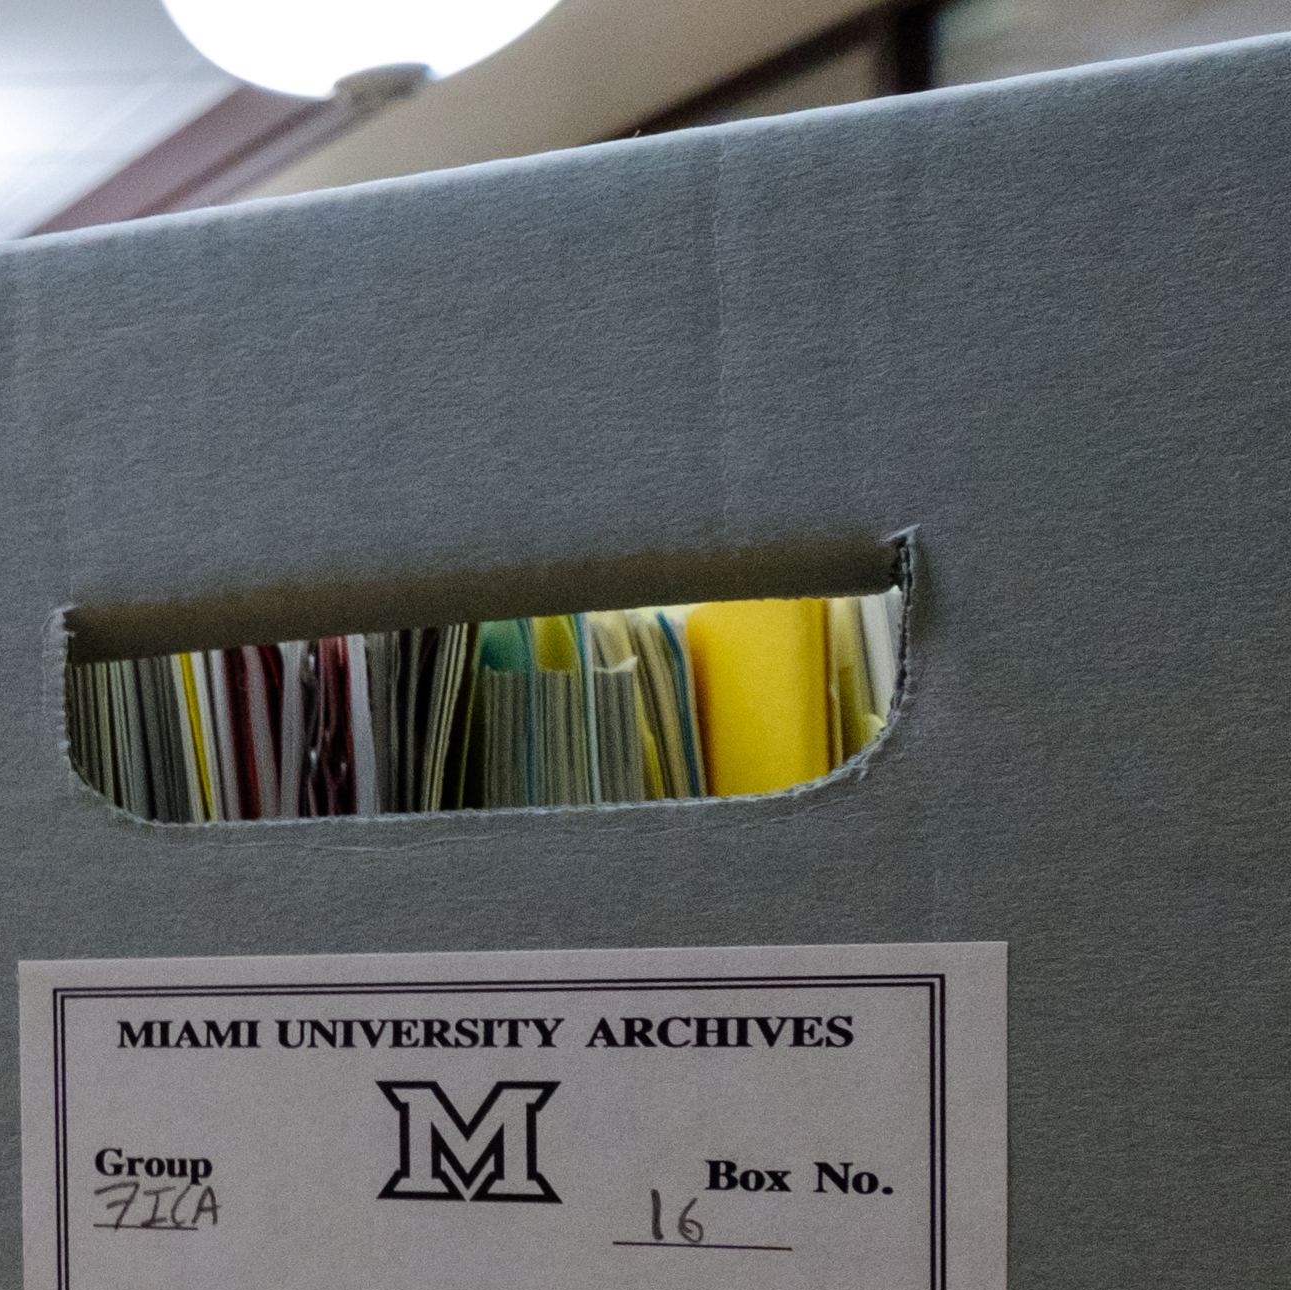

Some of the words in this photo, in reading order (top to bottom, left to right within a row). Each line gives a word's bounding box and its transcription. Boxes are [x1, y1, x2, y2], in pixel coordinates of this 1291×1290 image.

[117, 1019, 261, 1049] MIAMI
[276, 1018, 564, 1049] UNIVERSITY
[585, 1015, 854, 1048] ARCHIVES
[94, 1147, 213, 1186] Group
[704, 1160, 791, 1191] Box
[813, 1163, 894, 1195] No.
[650, 1190, 704, 1243] 16
